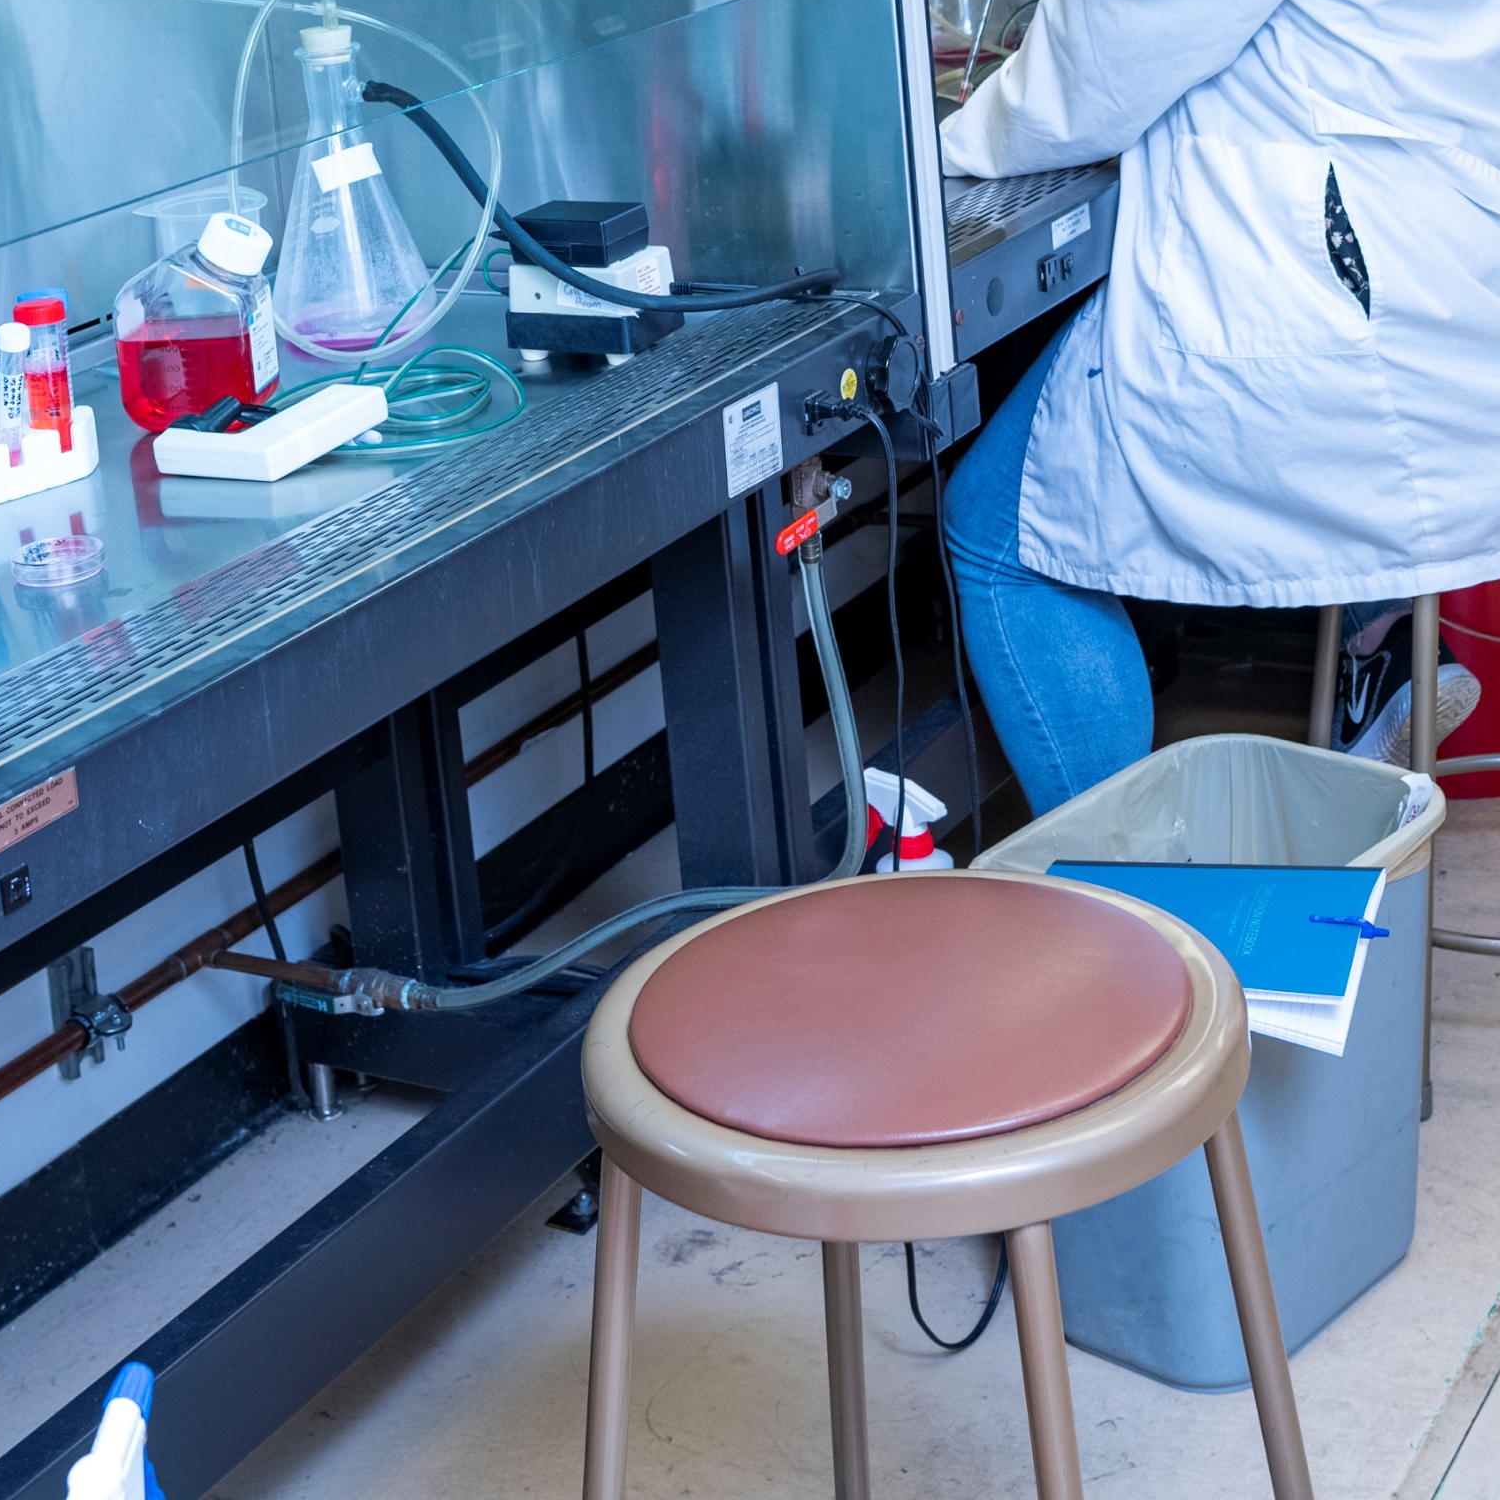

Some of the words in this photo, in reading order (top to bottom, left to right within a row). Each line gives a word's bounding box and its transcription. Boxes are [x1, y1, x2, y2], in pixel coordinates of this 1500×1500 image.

[5, 788, 45, 815] CONNECTED
[46, 777, 64, 792] LOAD
[15, 813, 24, 823] TO
[26, 797, 51, 815] EXCEED
[21, 816, 39, 831] AMPS
